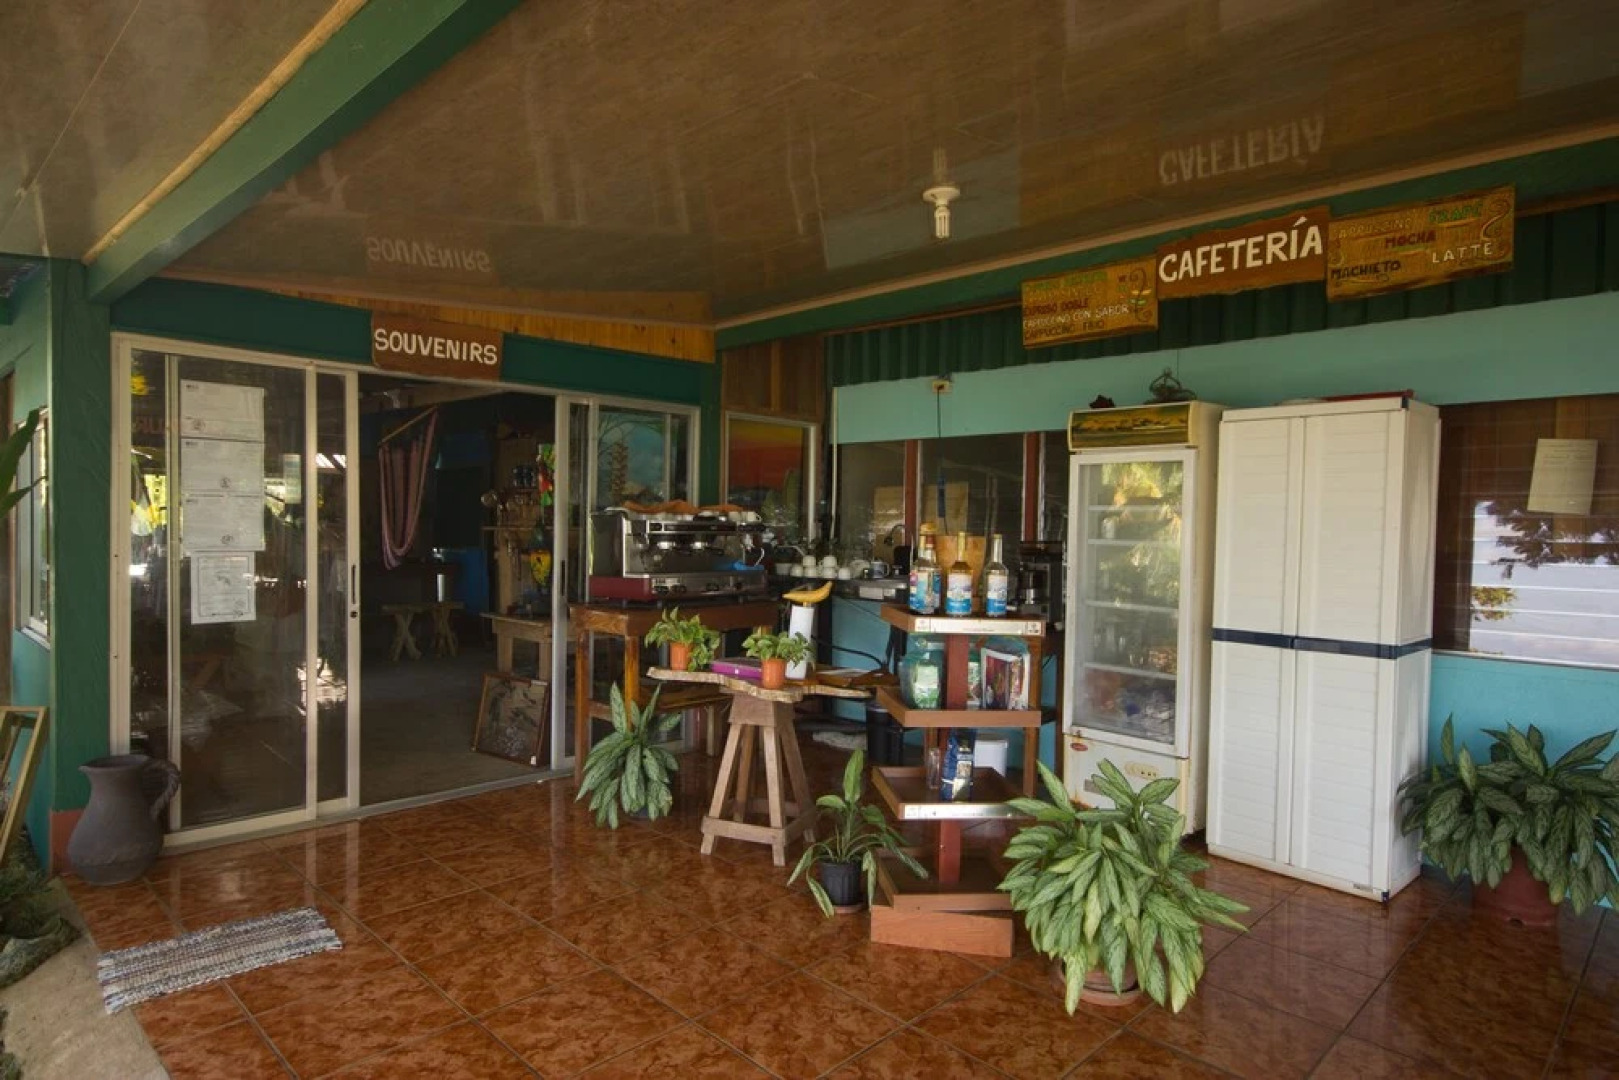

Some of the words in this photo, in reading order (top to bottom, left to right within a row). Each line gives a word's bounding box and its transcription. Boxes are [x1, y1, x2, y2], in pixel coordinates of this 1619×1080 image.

[1158, 216, 1324, 283] CAFETERÍA
[1386, 230, 1437, 248] MOCHA
[1432, 242, 1492, 263] LATTE
[1331, 259, 1402, 281] MACHIETO
[1095, 304, 1129, 319] SABOR
[373, 328, 498, 365] SOUVENIRS
